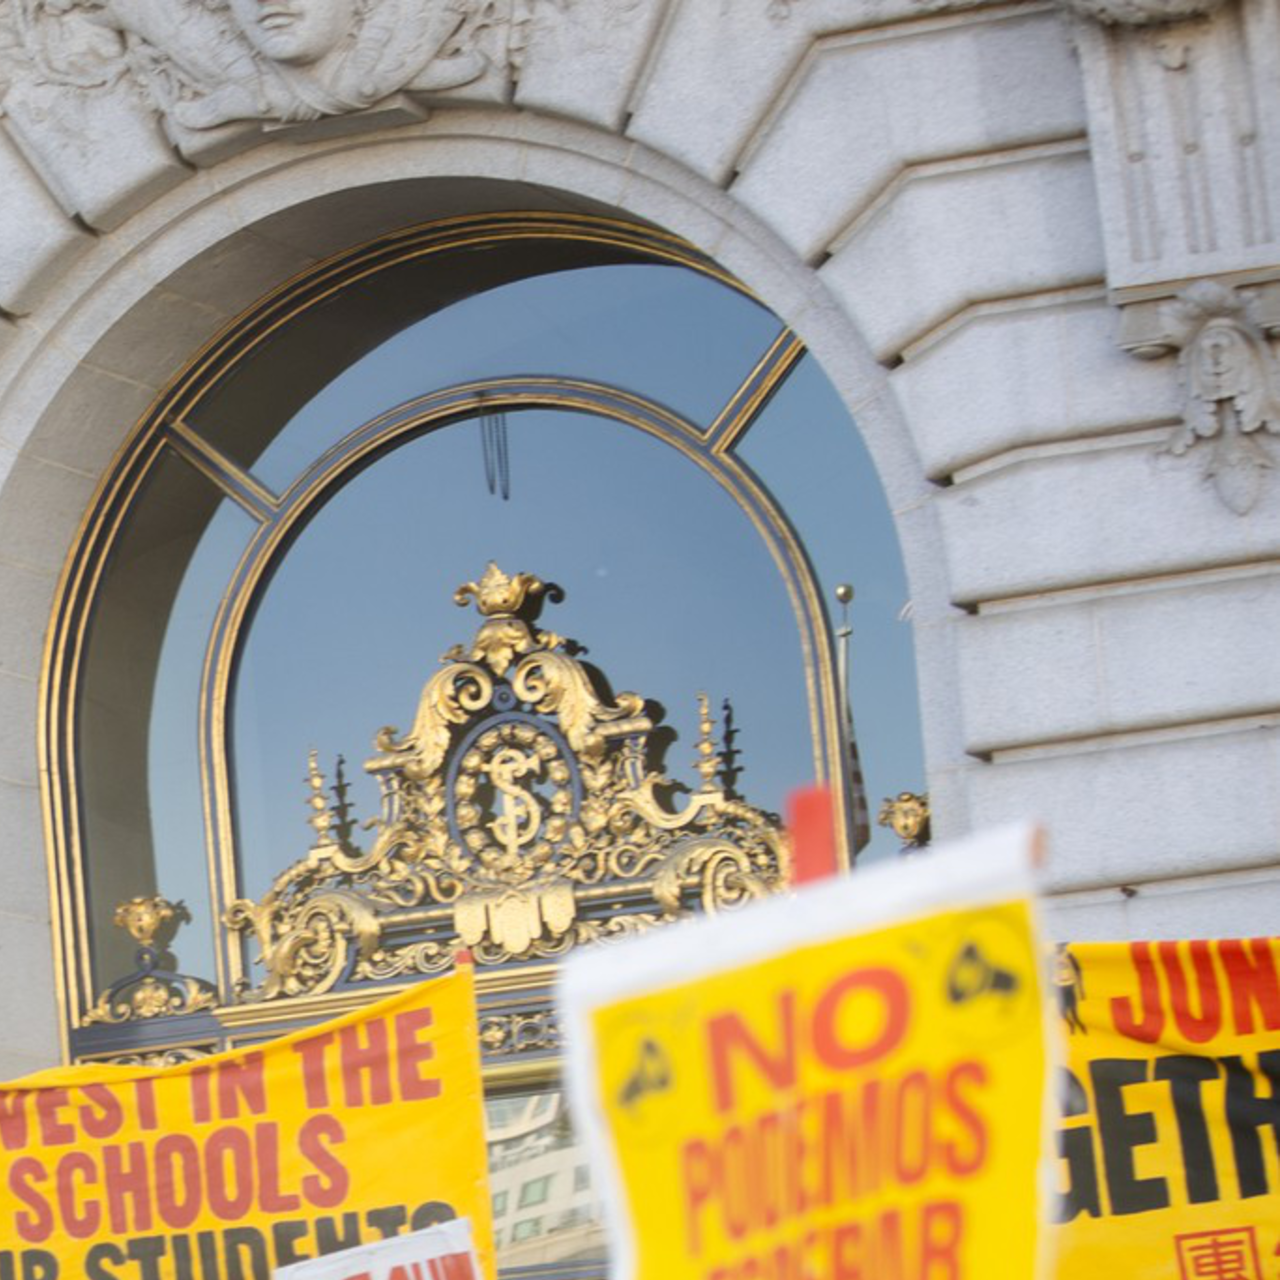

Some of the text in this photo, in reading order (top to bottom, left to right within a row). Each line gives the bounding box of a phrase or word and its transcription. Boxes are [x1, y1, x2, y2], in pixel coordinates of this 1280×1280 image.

[188, 1050, 266, 1124] IN
[293, 1007, 441, 1110] THE
[705, 967, 912, 1115] NO
[7, 1114, 351, 1244] SCHOOLS
[681, 1059, 989, 1256] PODEMOS
